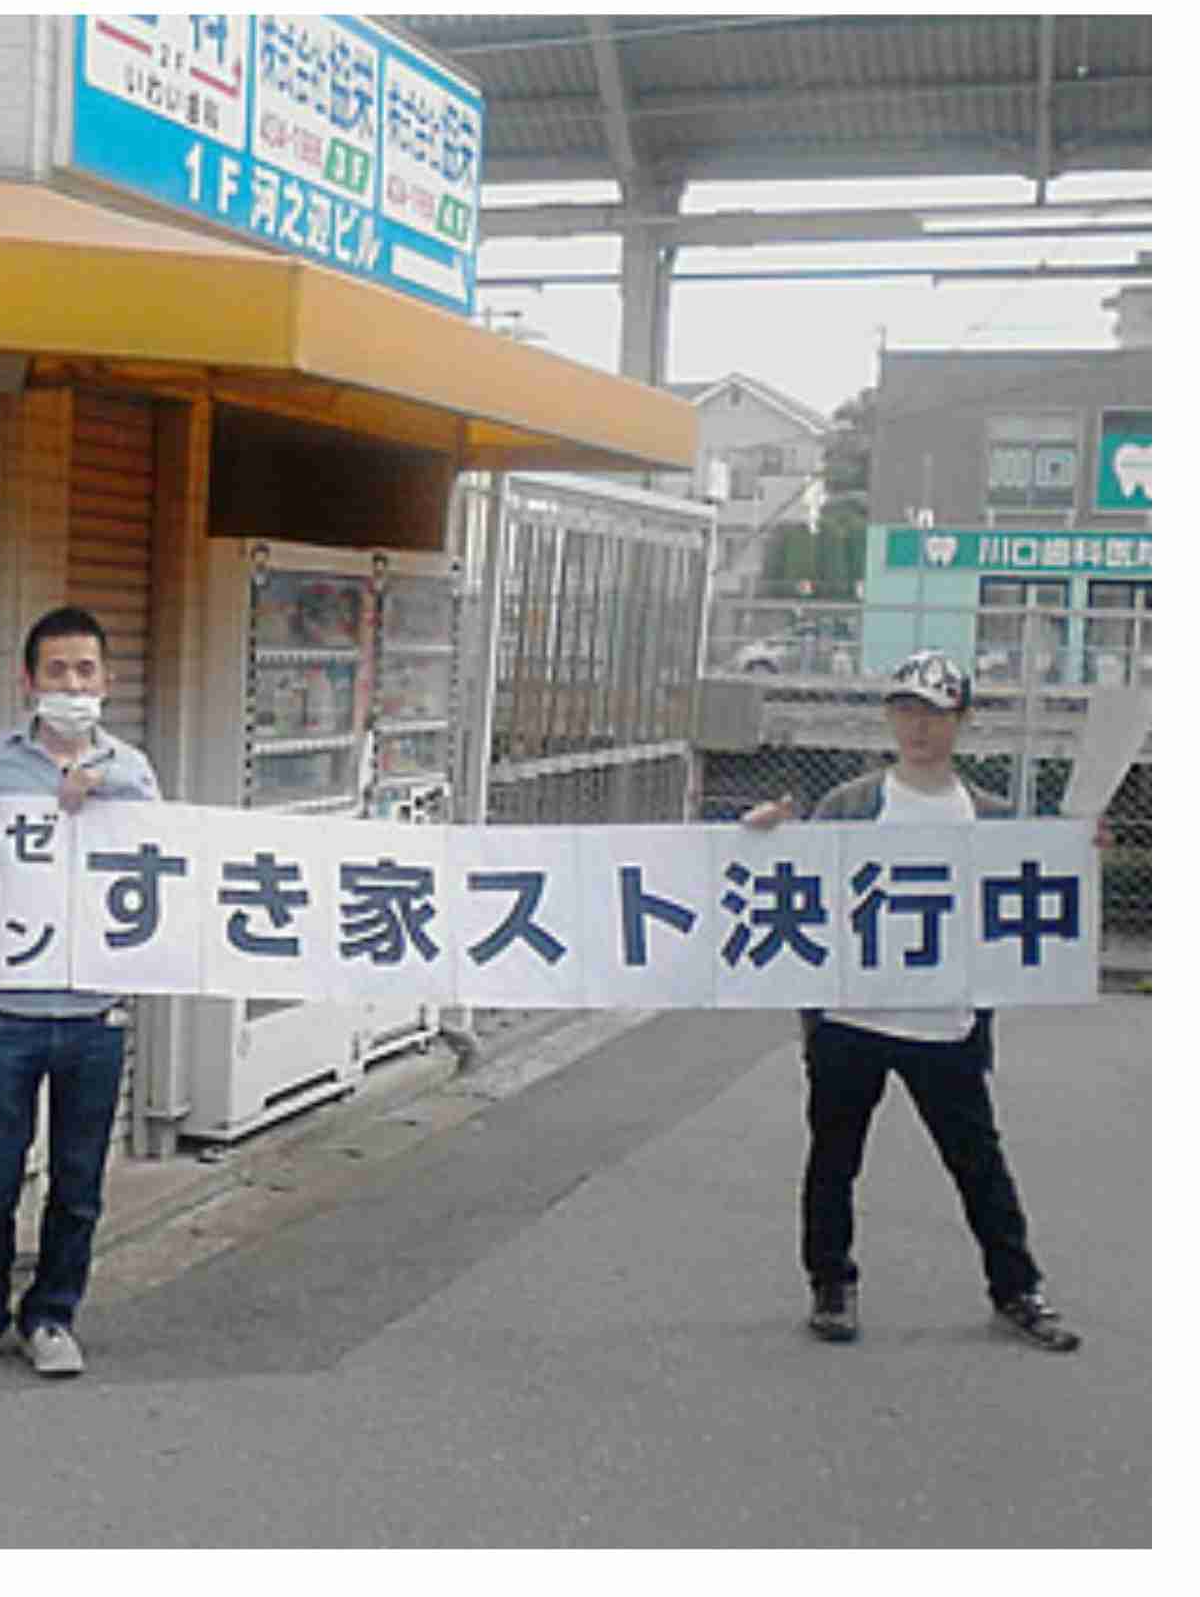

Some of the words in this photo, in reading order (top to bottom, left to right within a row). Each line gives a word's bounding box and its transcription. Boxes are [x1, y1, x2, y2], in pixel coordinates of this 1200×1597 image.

[86, 842, 1081, 969] すき家スト決行中
